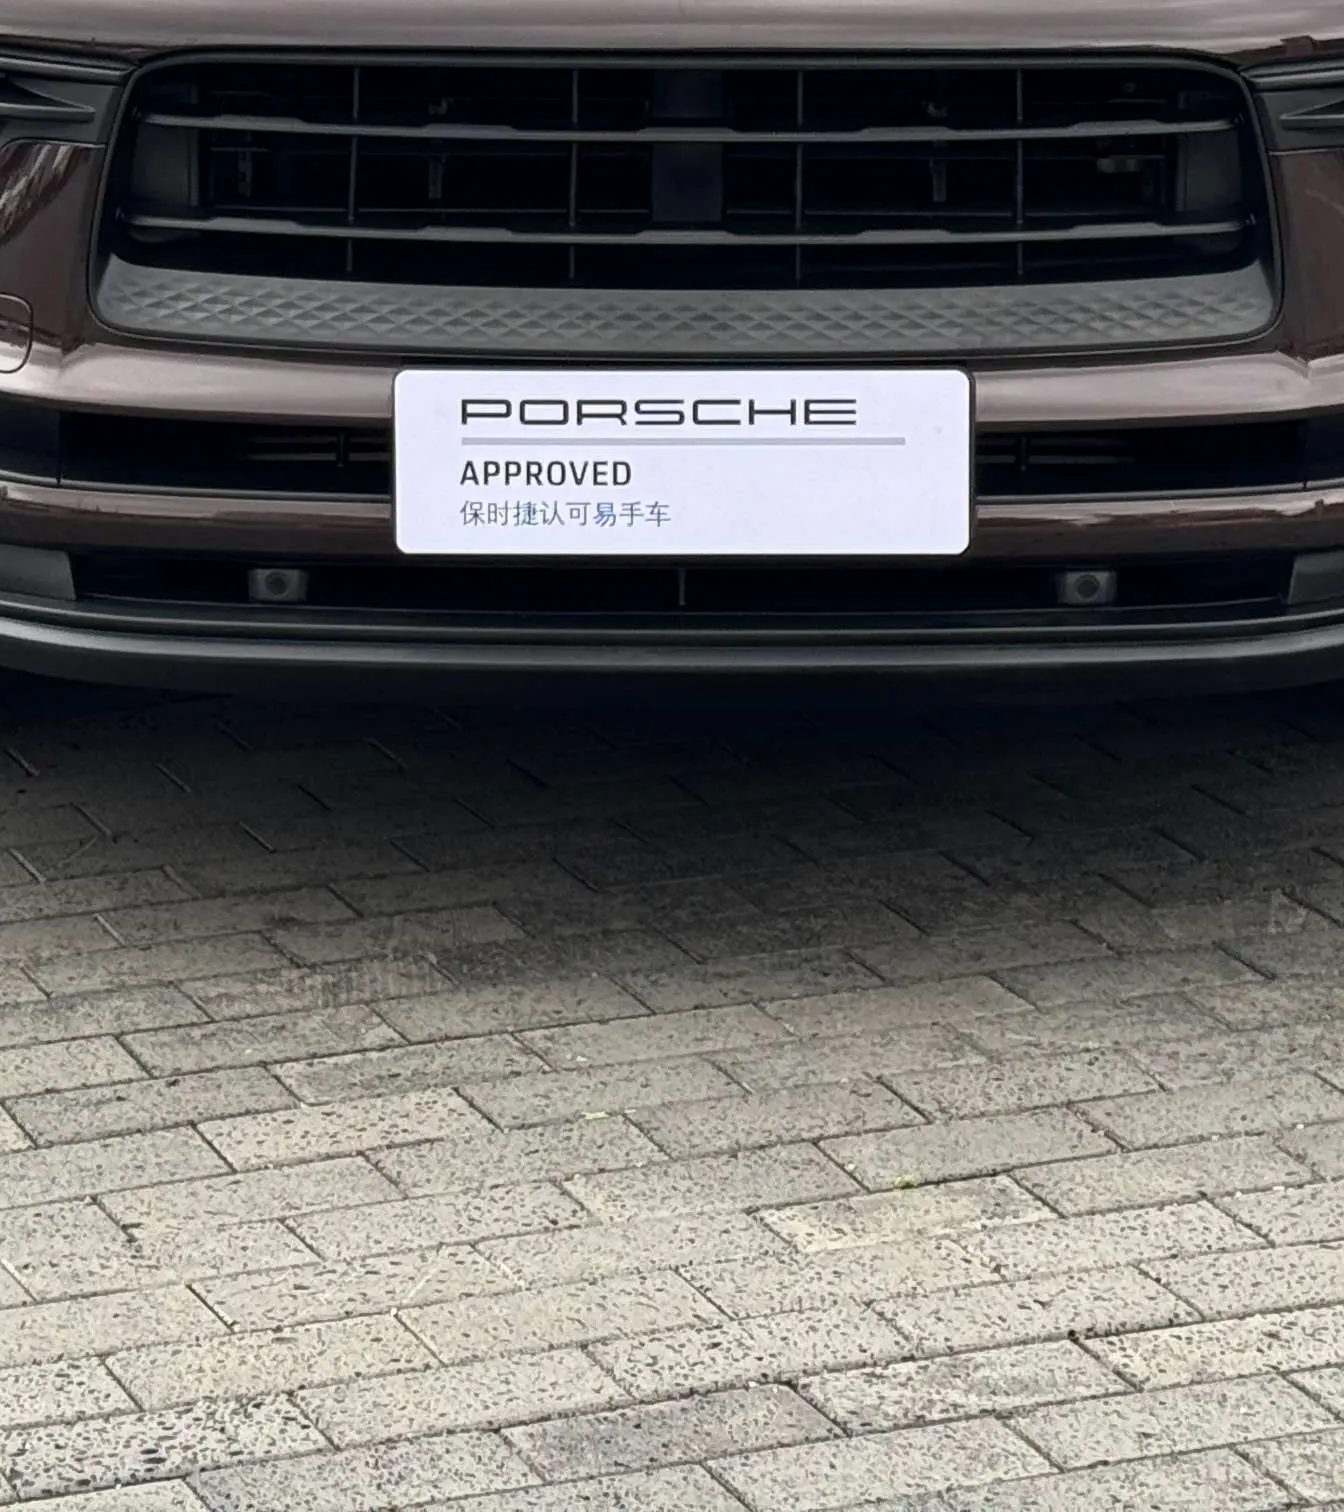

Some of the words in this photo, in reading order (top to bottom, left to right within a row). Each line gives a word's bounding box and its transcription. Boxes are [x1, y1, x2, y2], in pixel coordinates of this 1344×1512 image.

[460, 398, 857, 426] PORSCHE
[459, 460, 632, 486] APPROVED
[459, 500, 671, 528] 保时捷认可易手车
